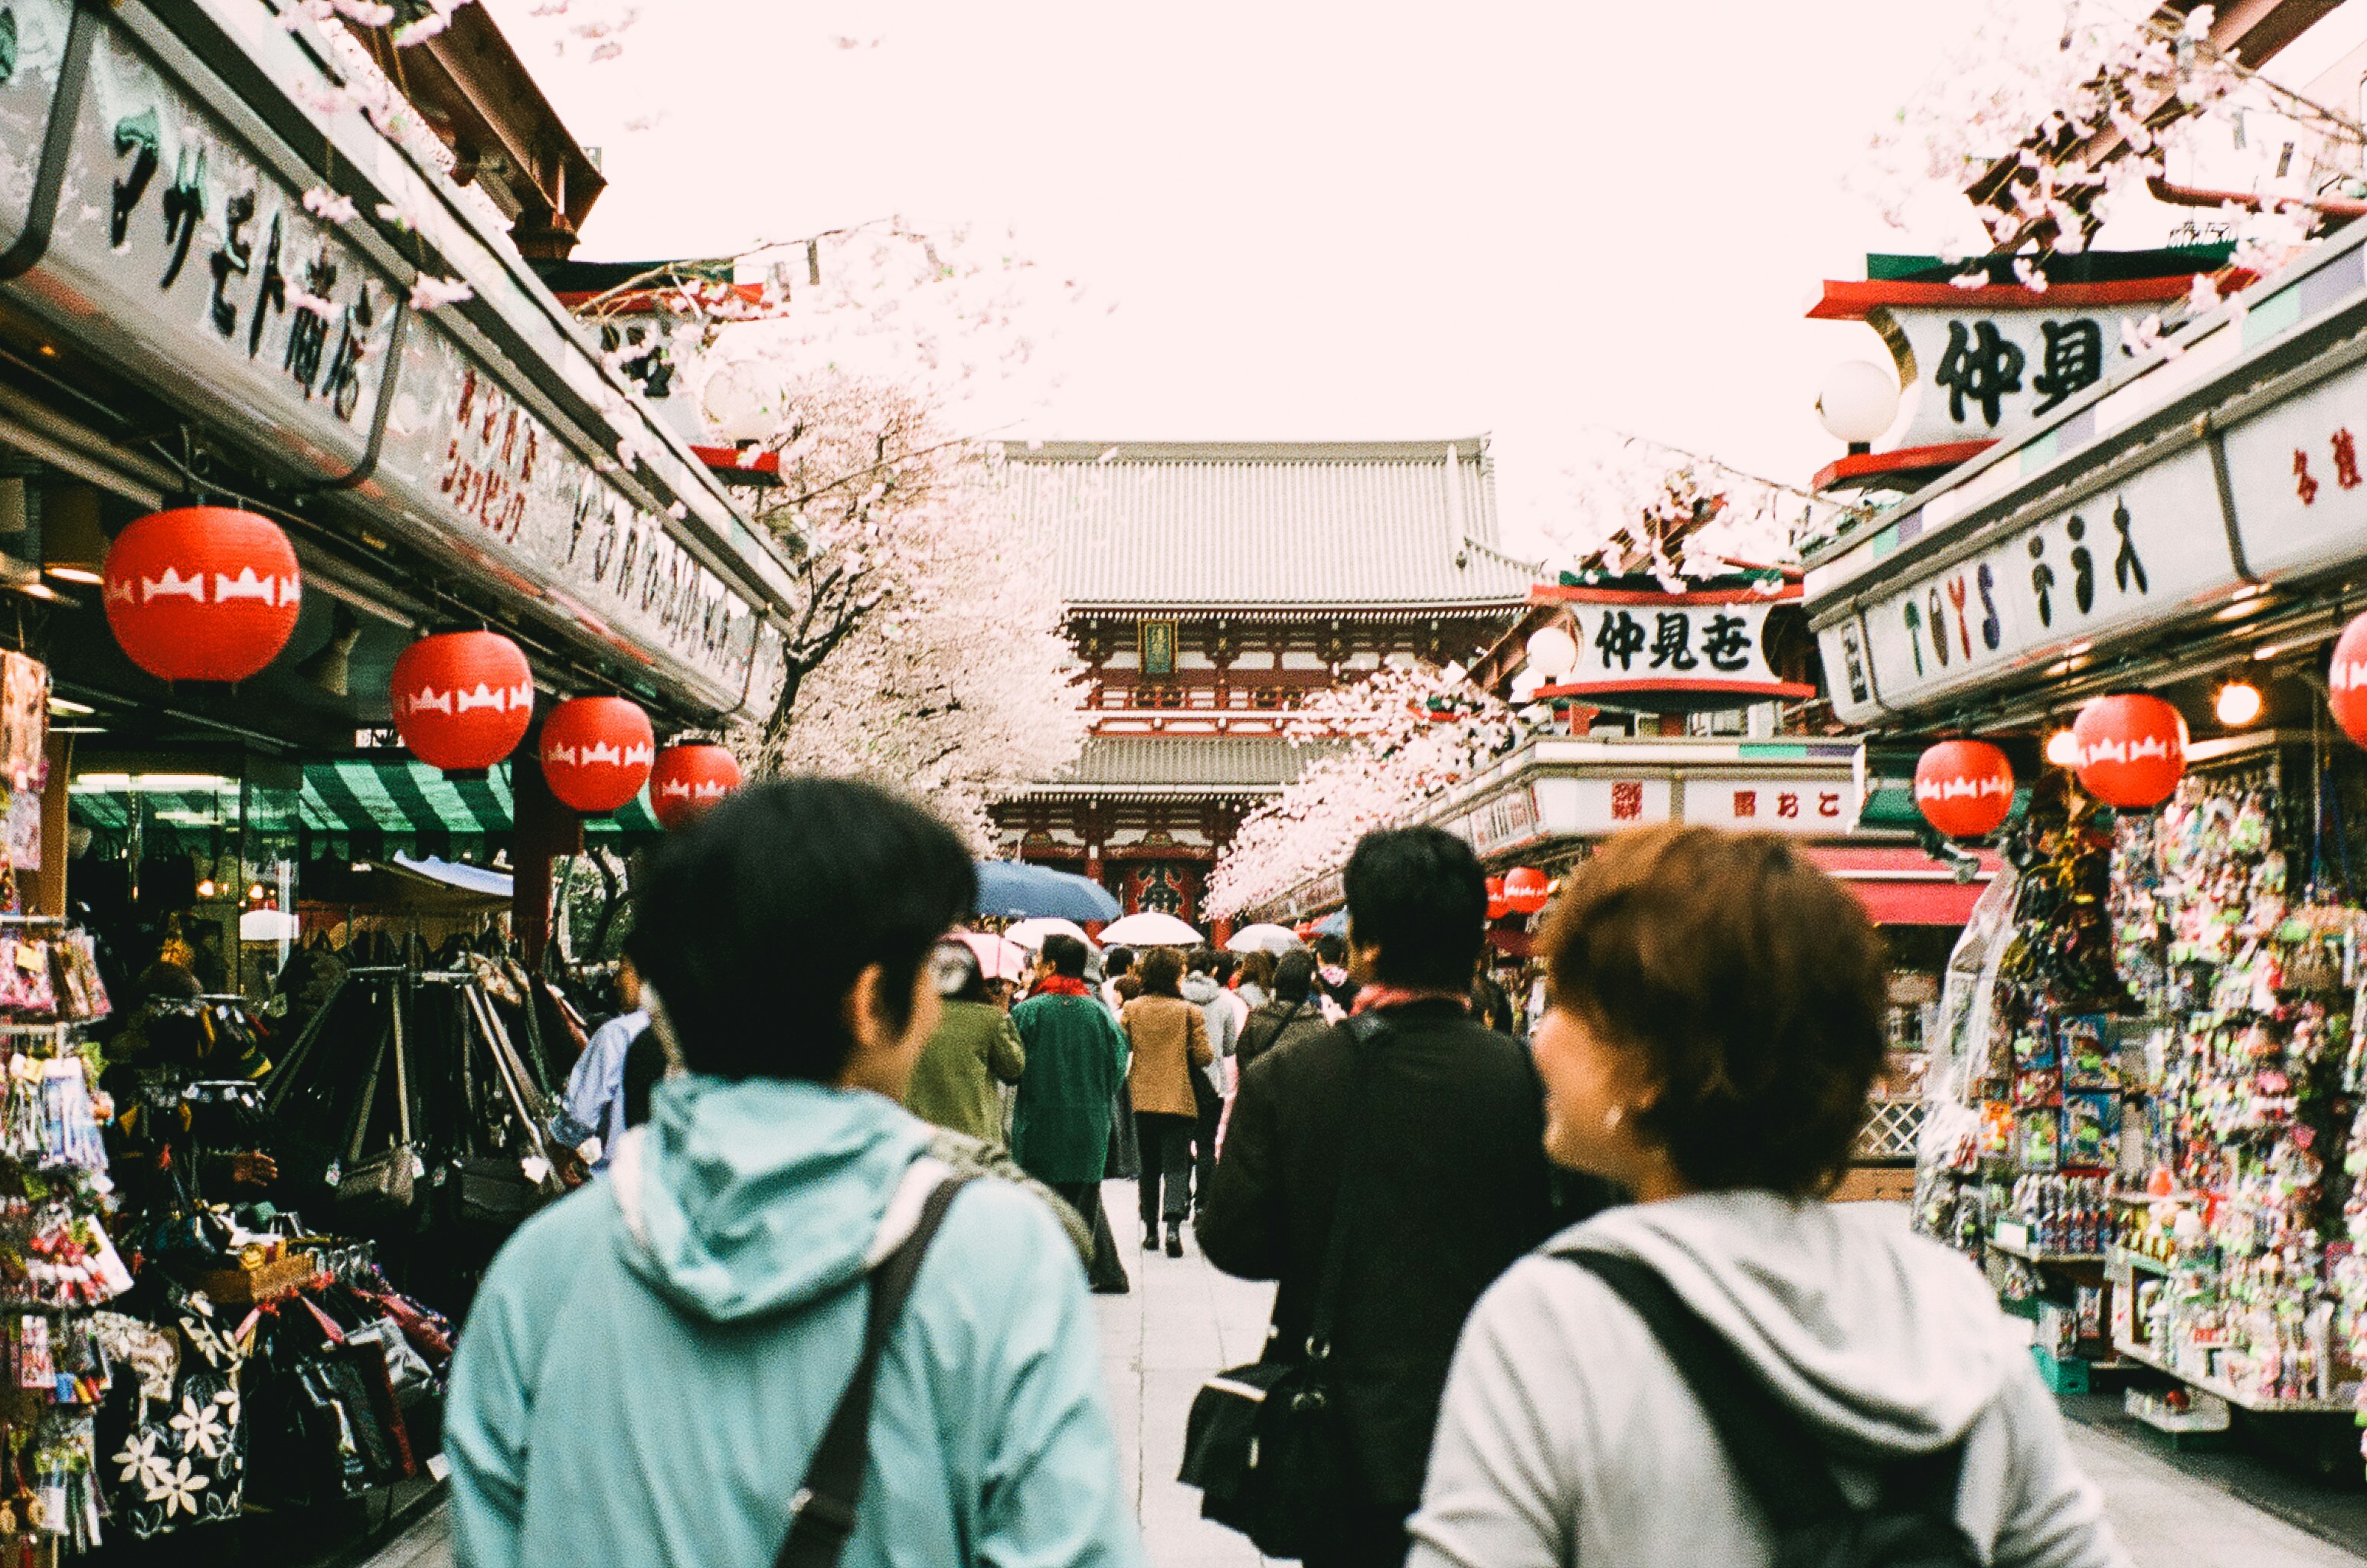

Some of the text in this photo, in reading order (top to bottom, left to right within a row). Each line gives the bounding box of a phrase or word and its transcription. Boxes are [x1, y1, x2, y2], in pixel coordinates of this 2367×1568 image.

[112, 108, 374, 423] アサモト商店
[1935, 318, 2137, 428] 仲見
[1596, 610, 1753, 671] 仲見世
[1904, 562, 2000, 678] TOYS
